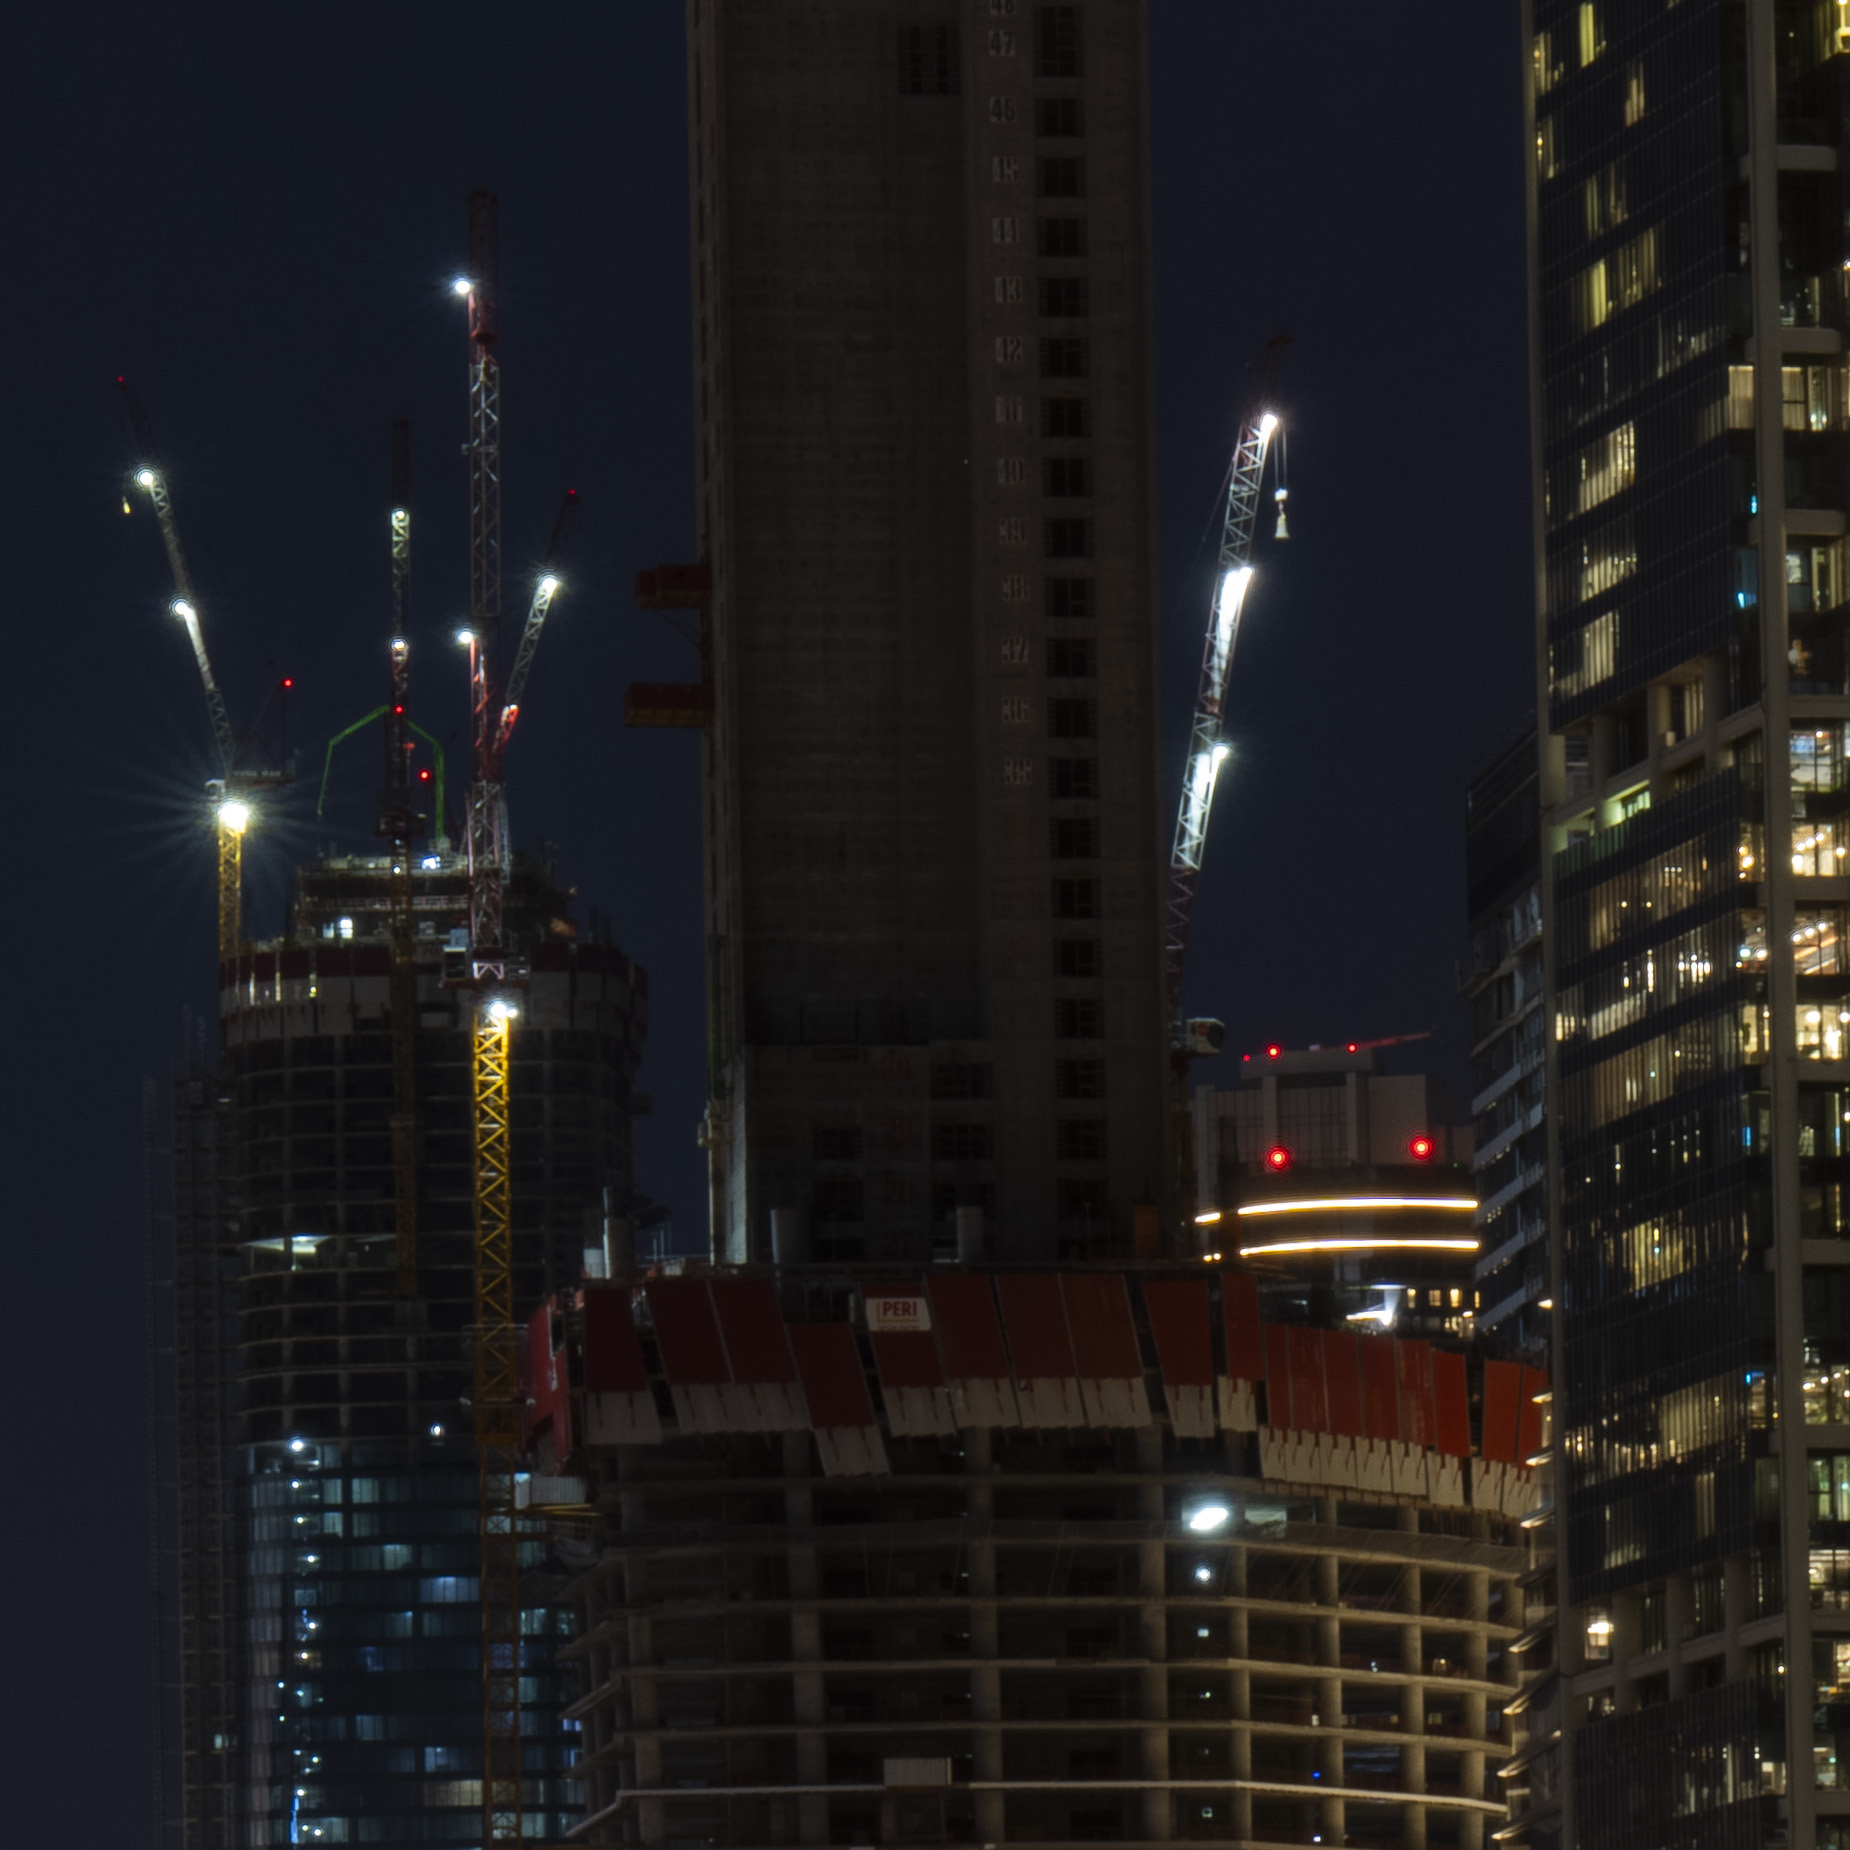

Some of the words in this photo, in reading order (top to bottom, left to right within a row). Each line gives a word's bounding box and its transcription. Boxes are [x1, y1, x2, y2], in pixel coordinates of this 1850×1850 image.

[989, 30, 1015, 56] 47
[990, 97, 1016, 122] 46
[996, 336, 1022, 362] 42
[1002, 636, 1028, 663] 37
[883, 1300, 918, 1317] PERI
